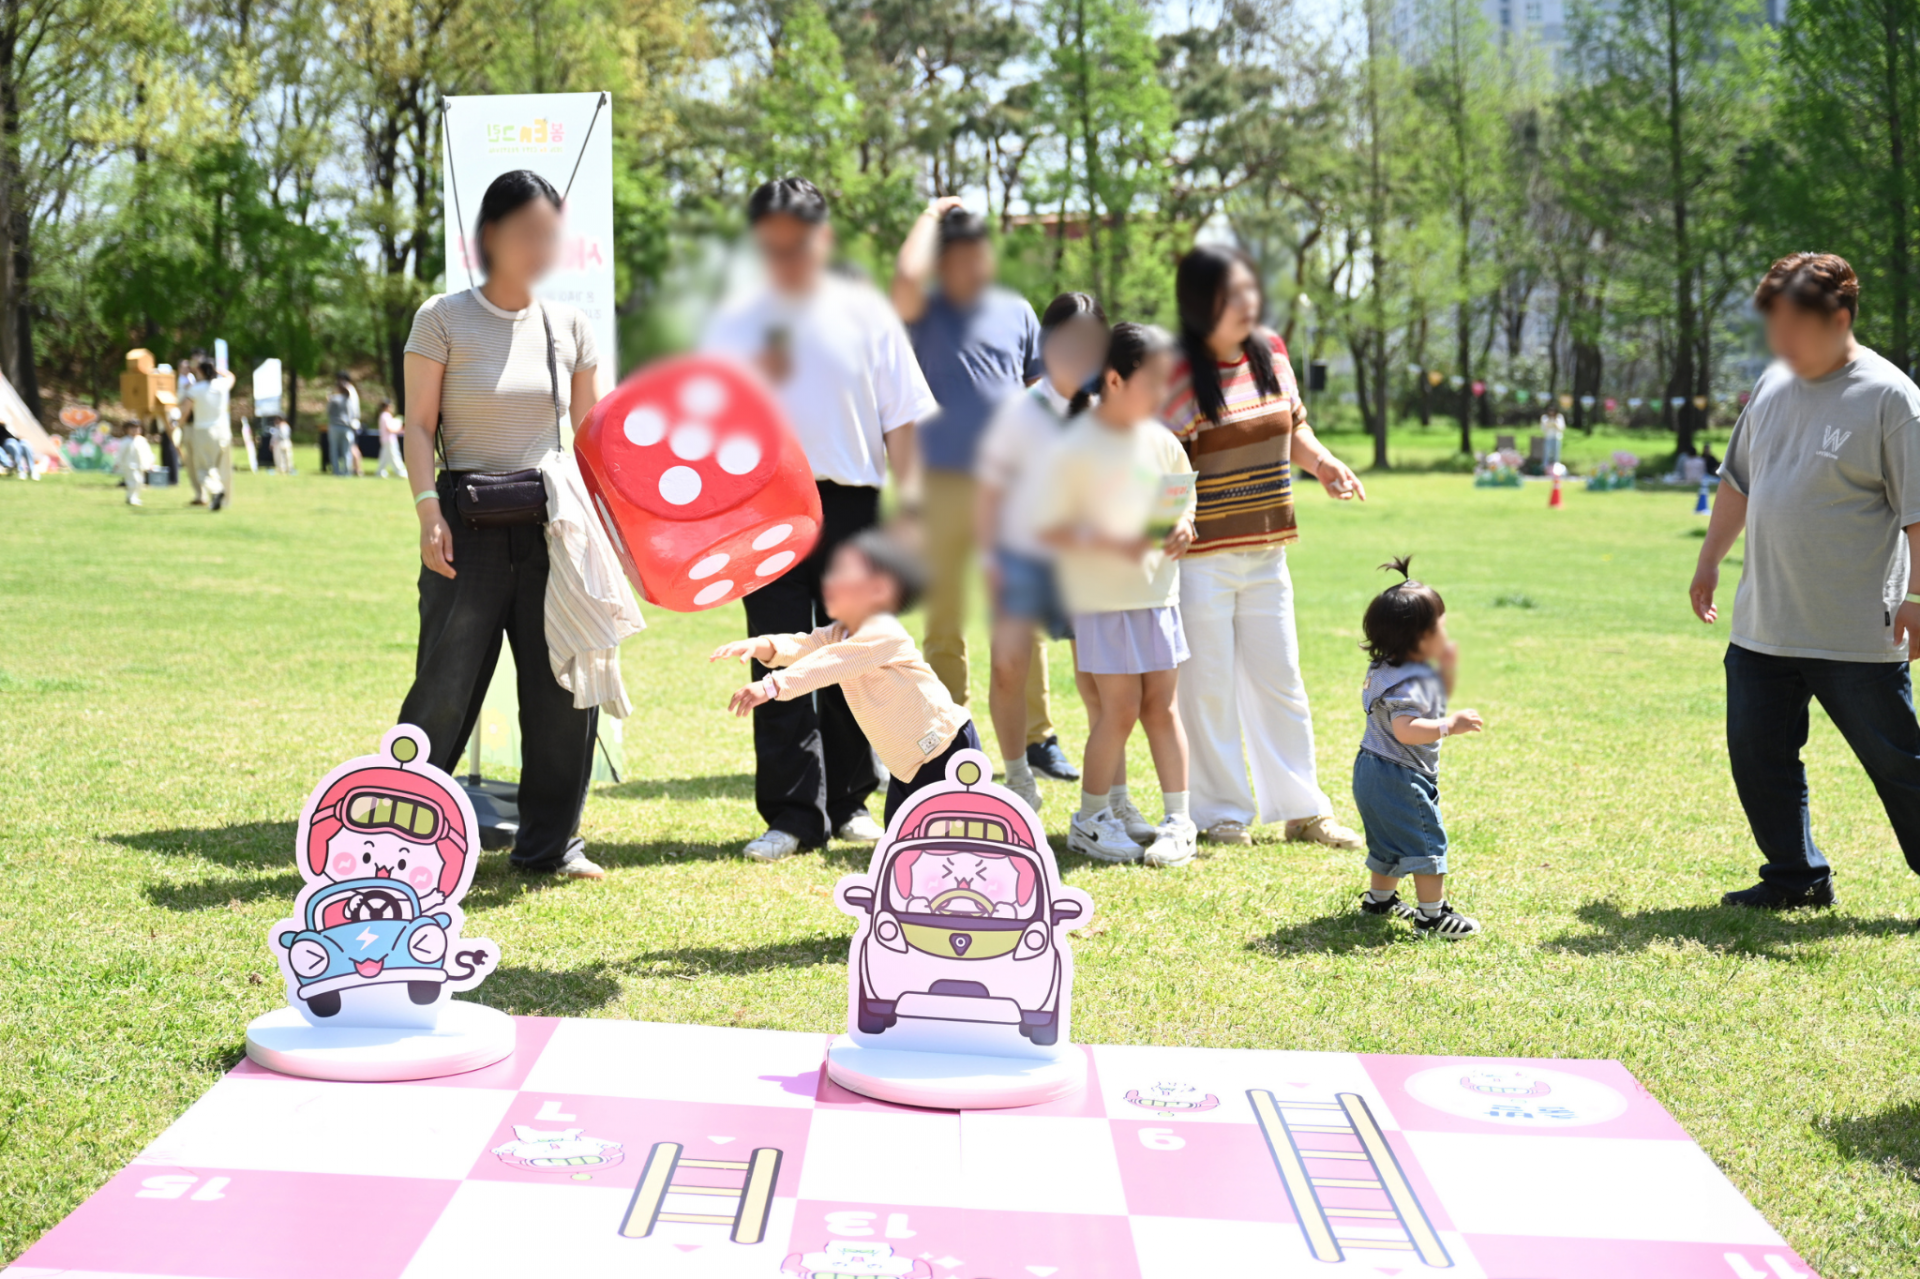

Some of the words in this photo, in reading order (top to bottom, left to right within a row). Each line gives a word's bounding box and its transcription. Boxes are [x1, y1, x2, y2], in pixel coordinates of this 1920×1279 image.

[1822, 425, 1852, 452] W
[534, 1101, 577, 1122] 7
[134, 1175, 232, 1202] 15
[823, 1211, 918, 1239] 13
